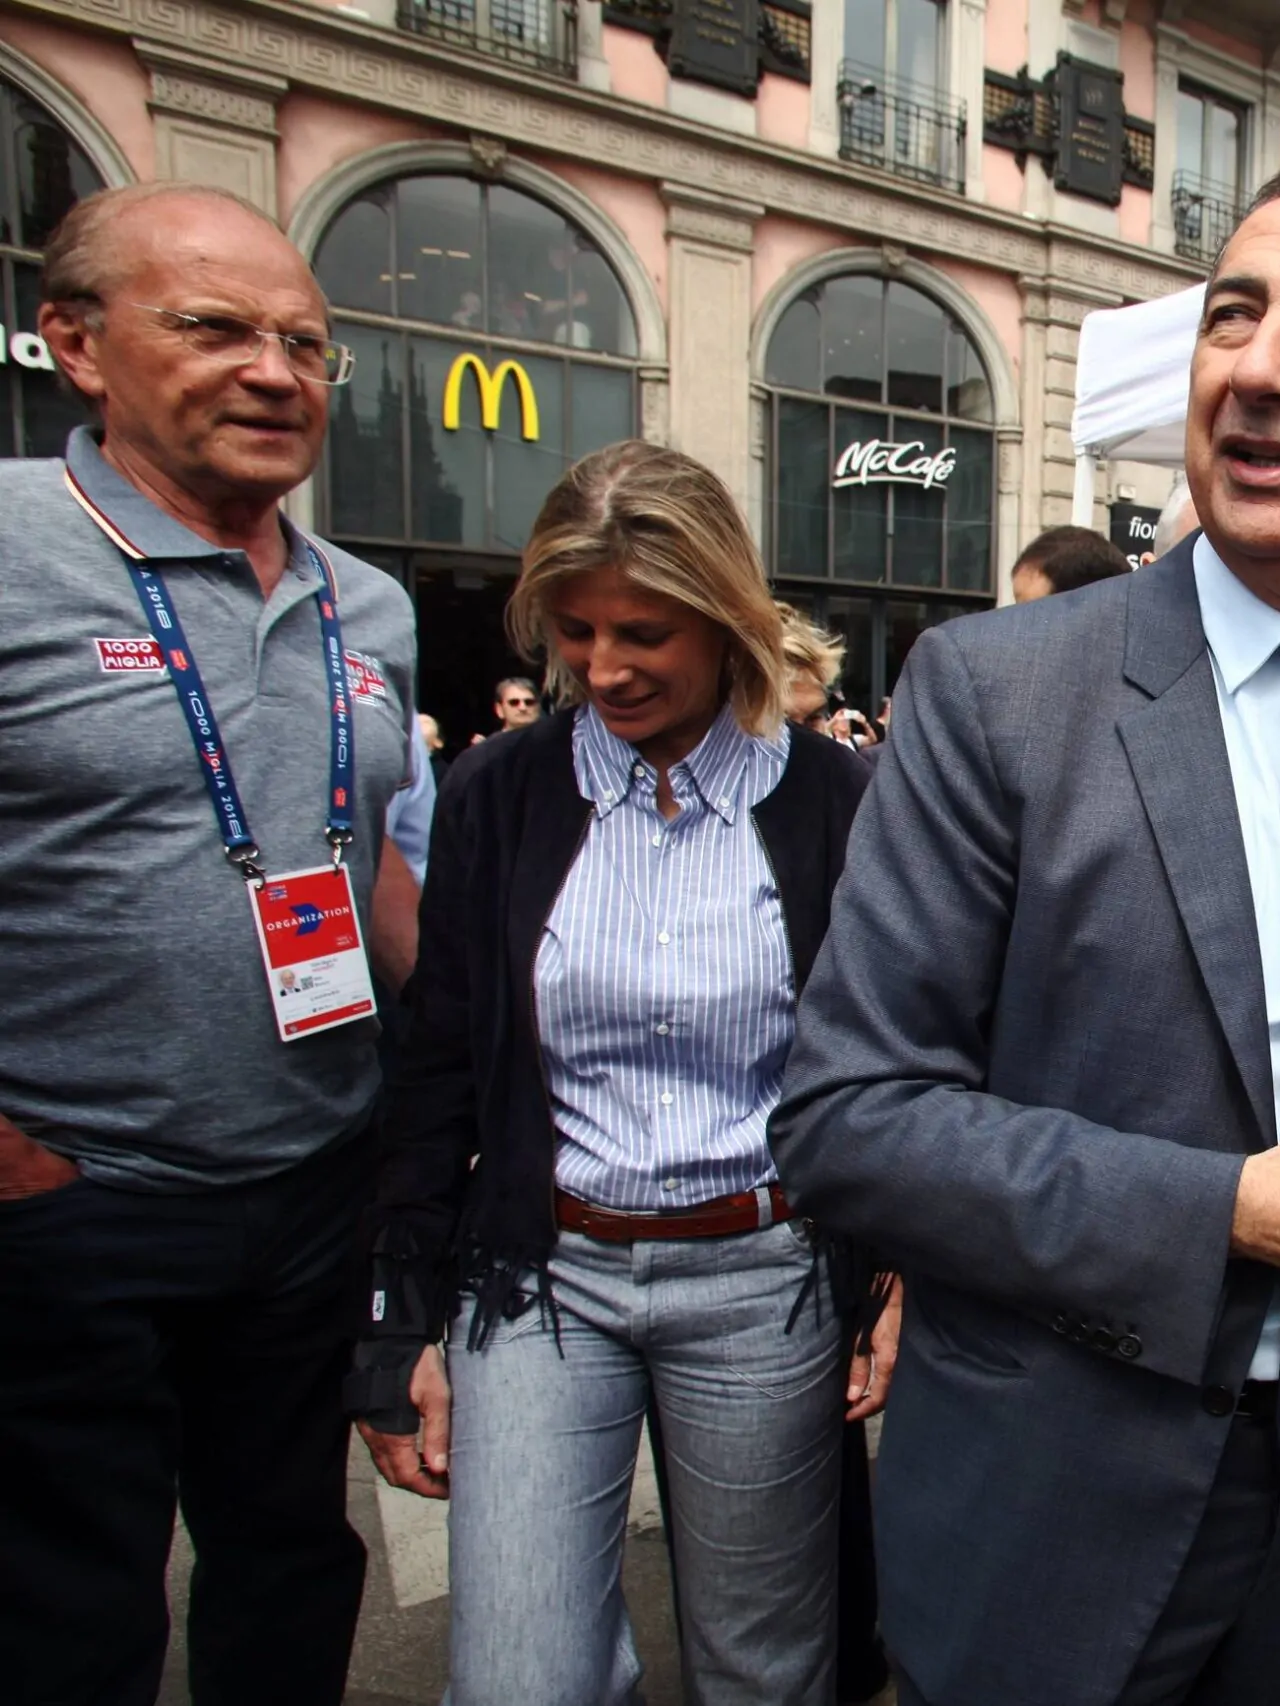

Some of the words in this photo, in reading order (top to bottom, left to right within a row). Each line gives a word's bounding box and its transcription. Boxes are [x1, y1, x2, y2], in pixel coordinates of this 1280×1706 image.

[104, 641, 153, 654] 1000
[105, 655, 161, 669] MIGLIA
[334, 680, 348, 723] MIGLIA
[188, 690, 212, 736] 1000
[204, 741, 227, 789] MIGLIA
[338, 729, 348, 769] 1000
[266, 905, 350, 931] ORGANIZATION
